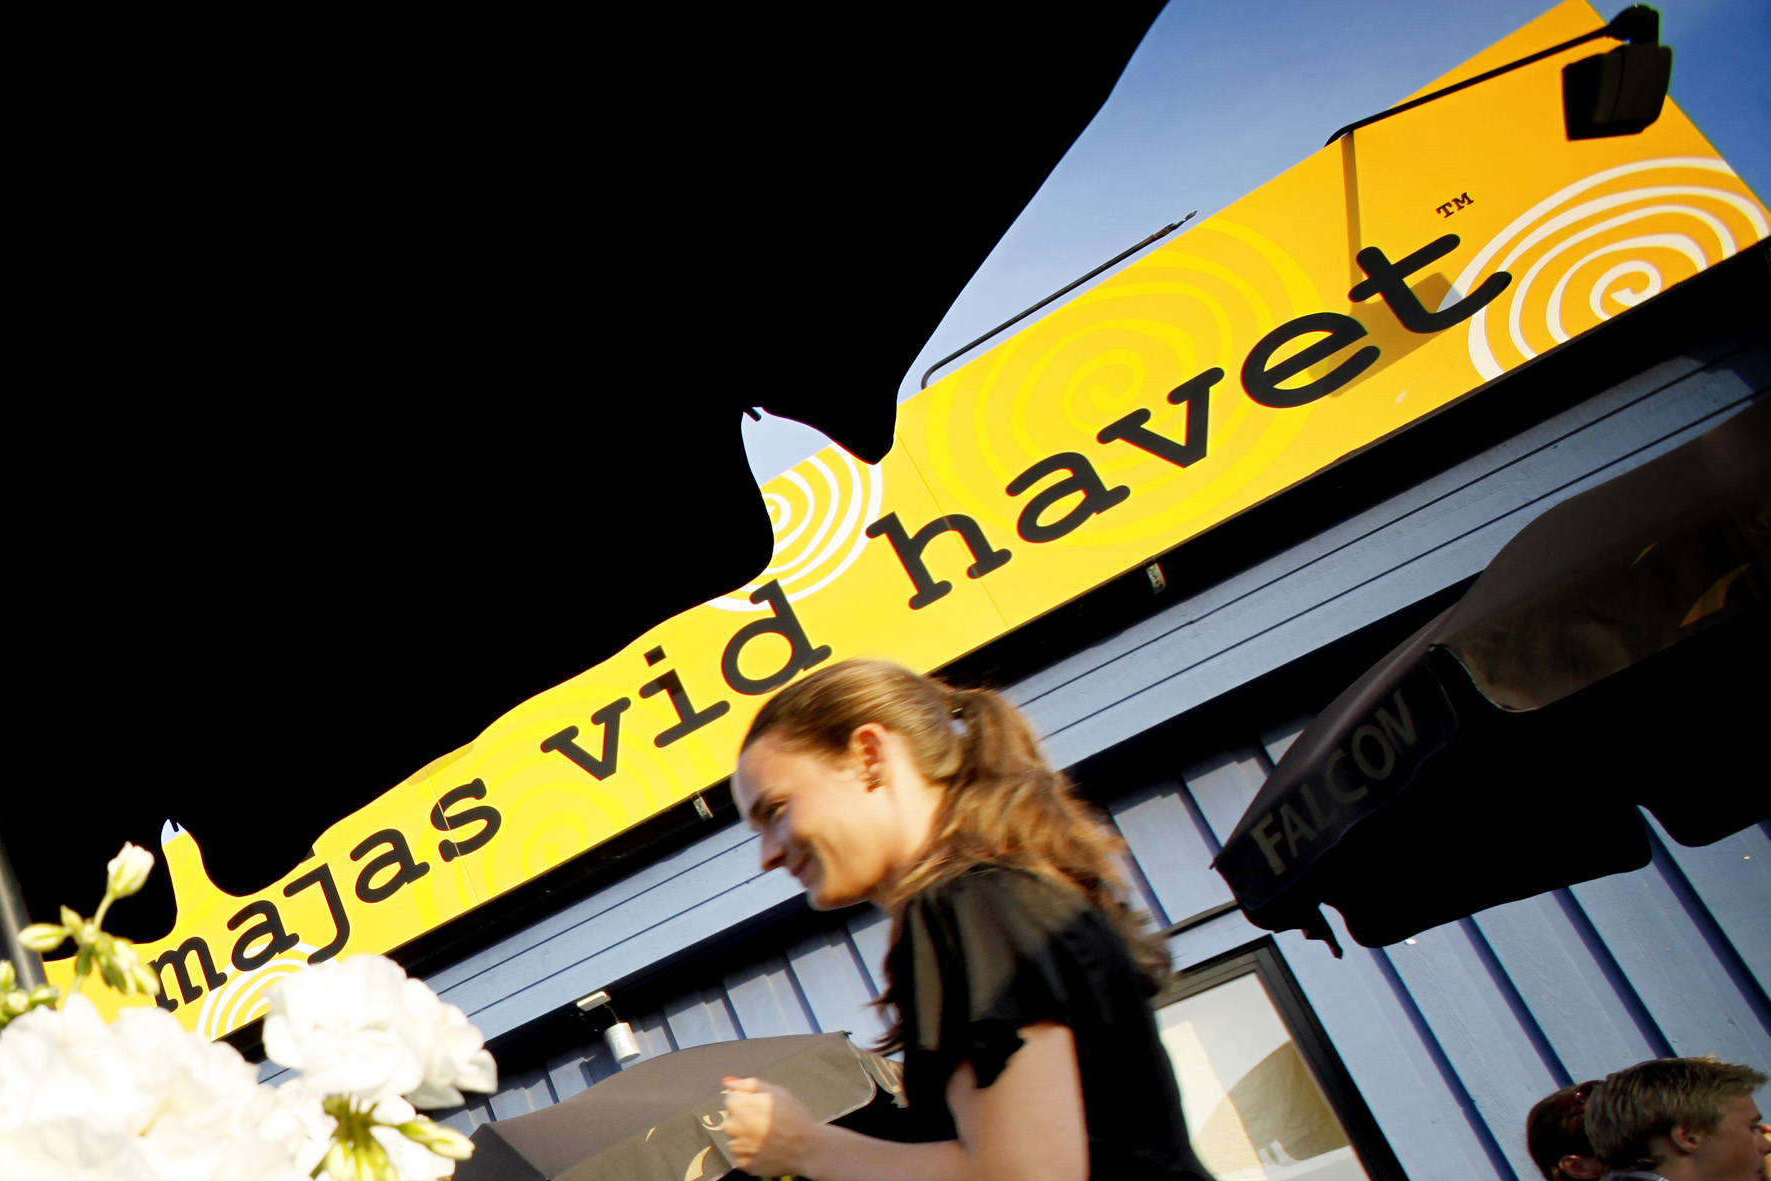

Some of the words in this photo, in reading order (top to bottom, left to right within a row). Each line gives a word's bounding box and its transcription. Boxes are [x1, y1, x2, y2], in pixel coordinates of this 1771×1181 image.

[1435, 192, 1475, 218] TM
[150, 778, 502, 1014] majas
[540, 578, 832, 781] vid
[865, 234, 1513, 610] havet
[1248, 689, 1419, 875] FALCON
